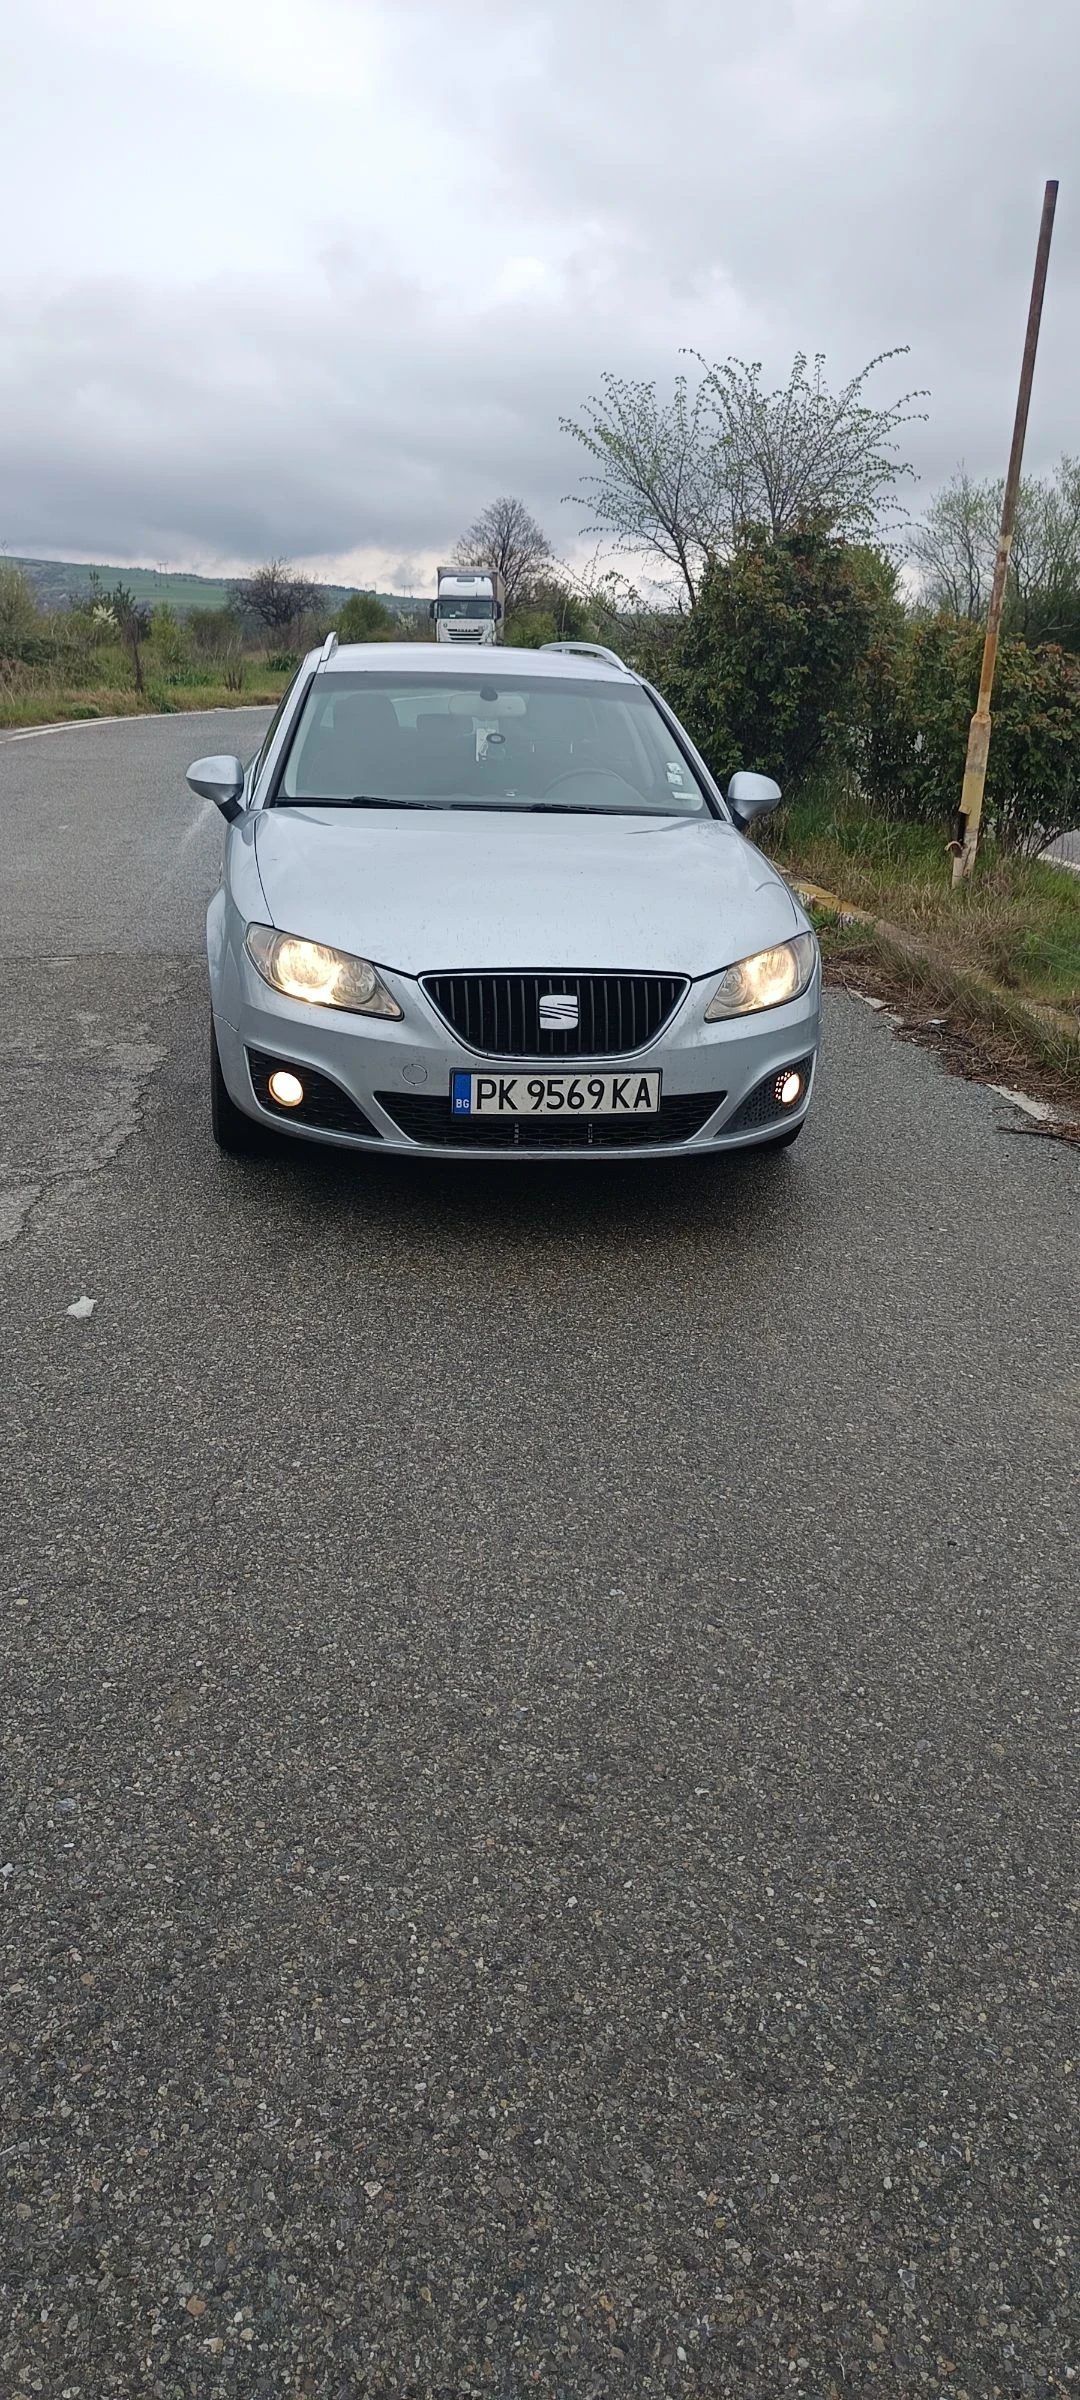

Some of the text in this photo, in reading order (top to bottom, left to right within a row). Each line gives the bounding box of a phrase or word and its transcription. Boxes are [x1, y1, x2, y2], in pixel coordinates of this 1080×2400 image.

[456, 1099, 470, 1108] BG
[476, 1078, 651, 1110] PK 9569 KA
